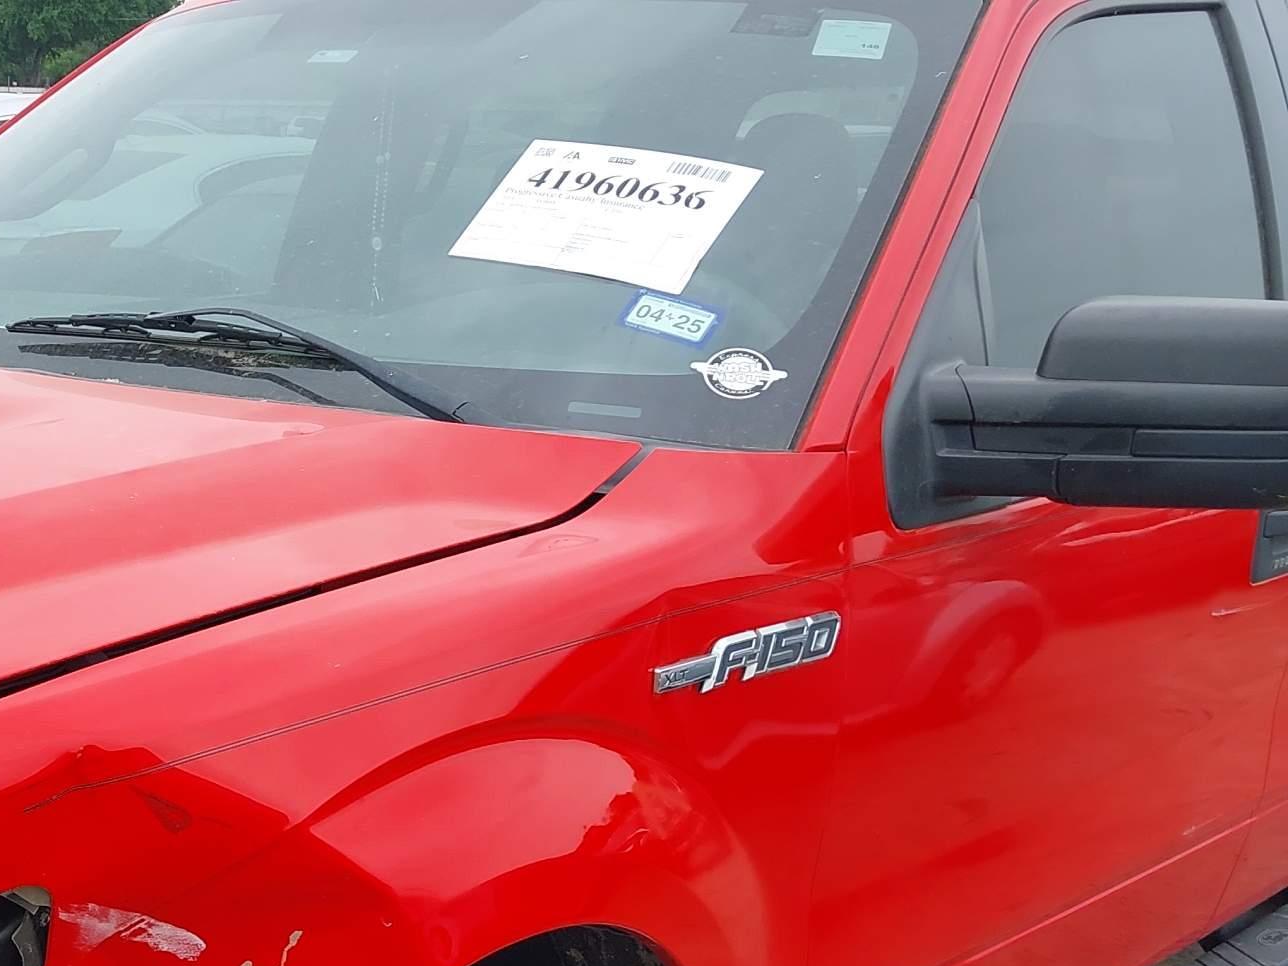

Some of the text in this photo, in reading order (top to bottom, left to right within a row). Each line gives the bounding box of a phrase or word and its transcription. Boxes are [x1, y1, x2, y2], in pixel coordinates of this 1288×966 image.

[527, 167, 715, 209] 41960636
[600, 198, 643, 210] Insurance
[636, 304, 666, 322] 04
[672, 315, 705, 333] 25
[664, 610, 842, 694] XLT F-150
